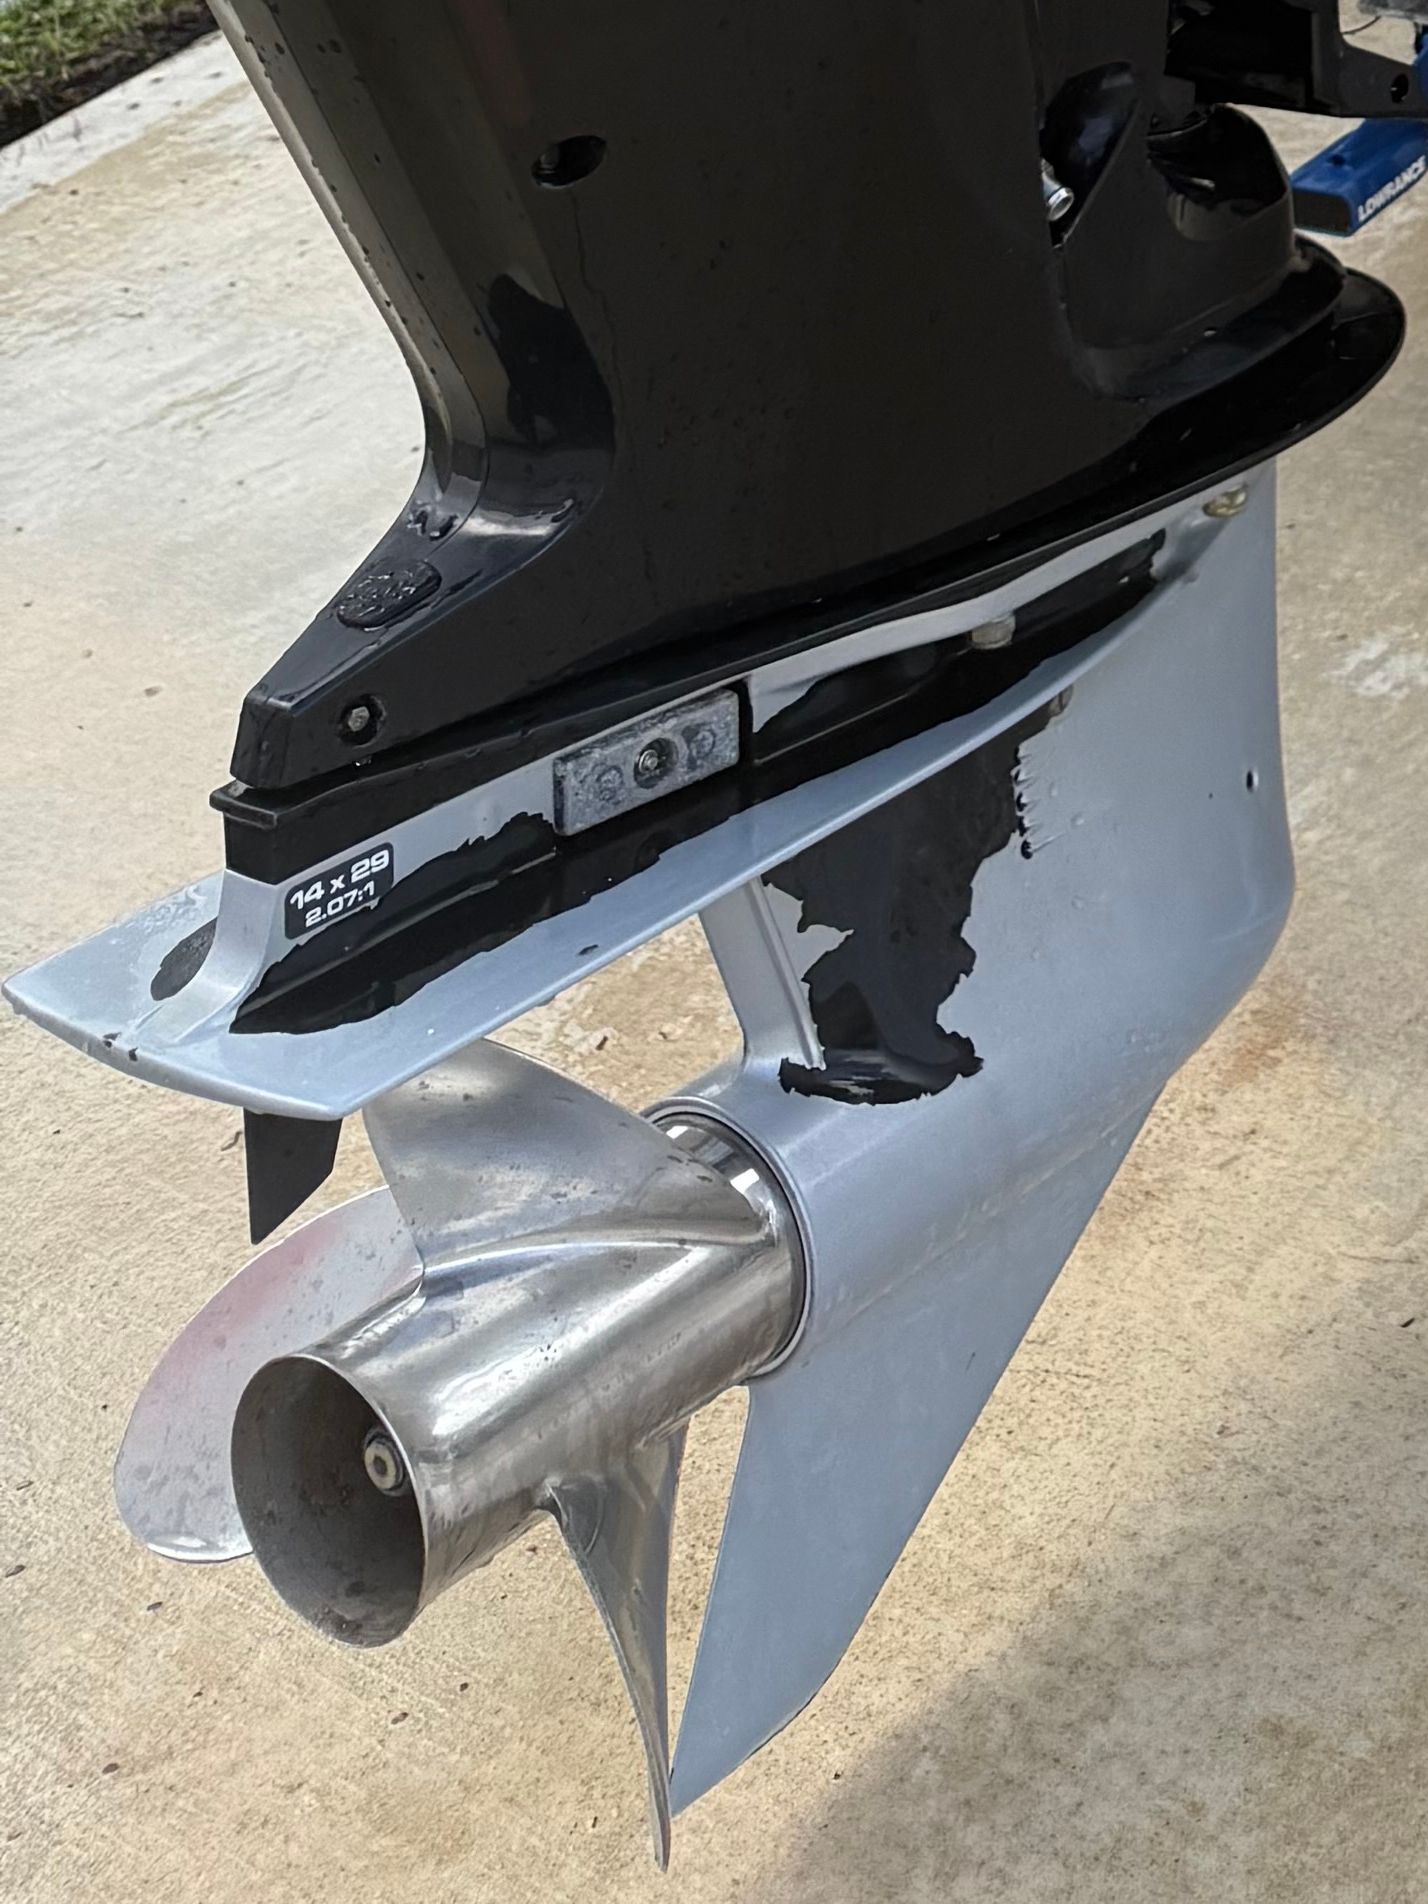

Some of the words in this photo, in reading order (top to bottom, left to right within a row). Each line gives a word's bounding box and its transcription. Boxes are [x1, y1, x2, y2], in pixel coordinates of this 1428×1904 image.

[1358, 155, 1427, 222] LOWRANCE
[290, 880, 325, 910] 14
[330, 873, 346, 894] x
[350, 849, 391, 882] 29
[305, 880, 375, 927] 2.07:1
